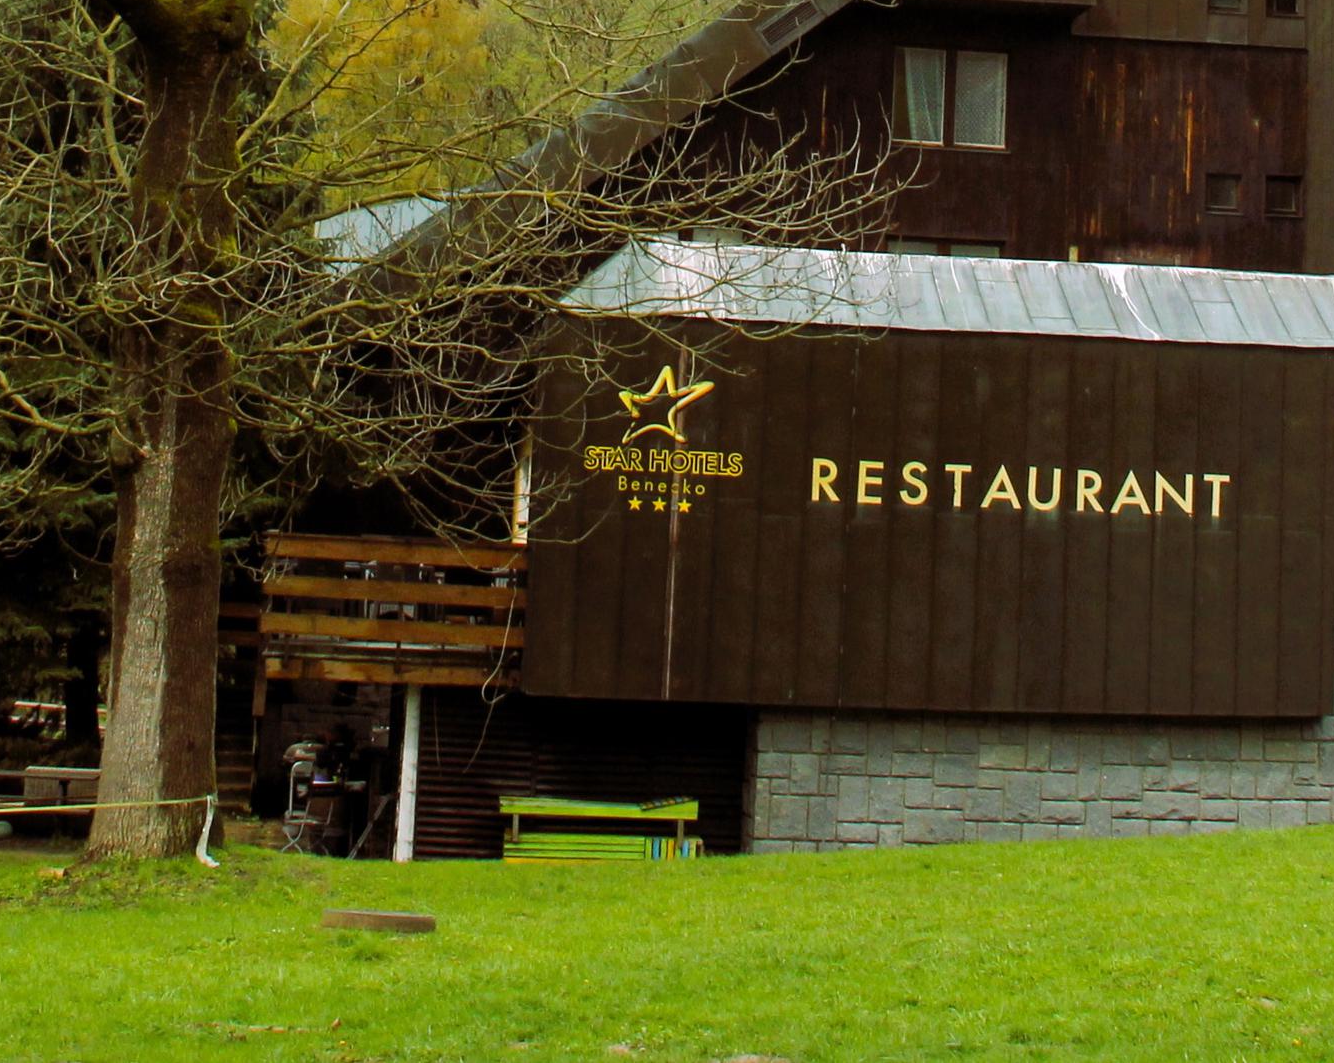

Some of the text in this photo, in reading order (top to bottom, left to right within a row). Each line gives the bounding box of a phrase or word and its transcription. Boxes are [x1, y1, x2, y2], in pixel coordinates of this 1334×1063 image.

[584, 445, 744, 477] STAR HOTELS
[618, 475, 706, 496] Benecko
[810, 457, 1231, 518] RESTAURANT
